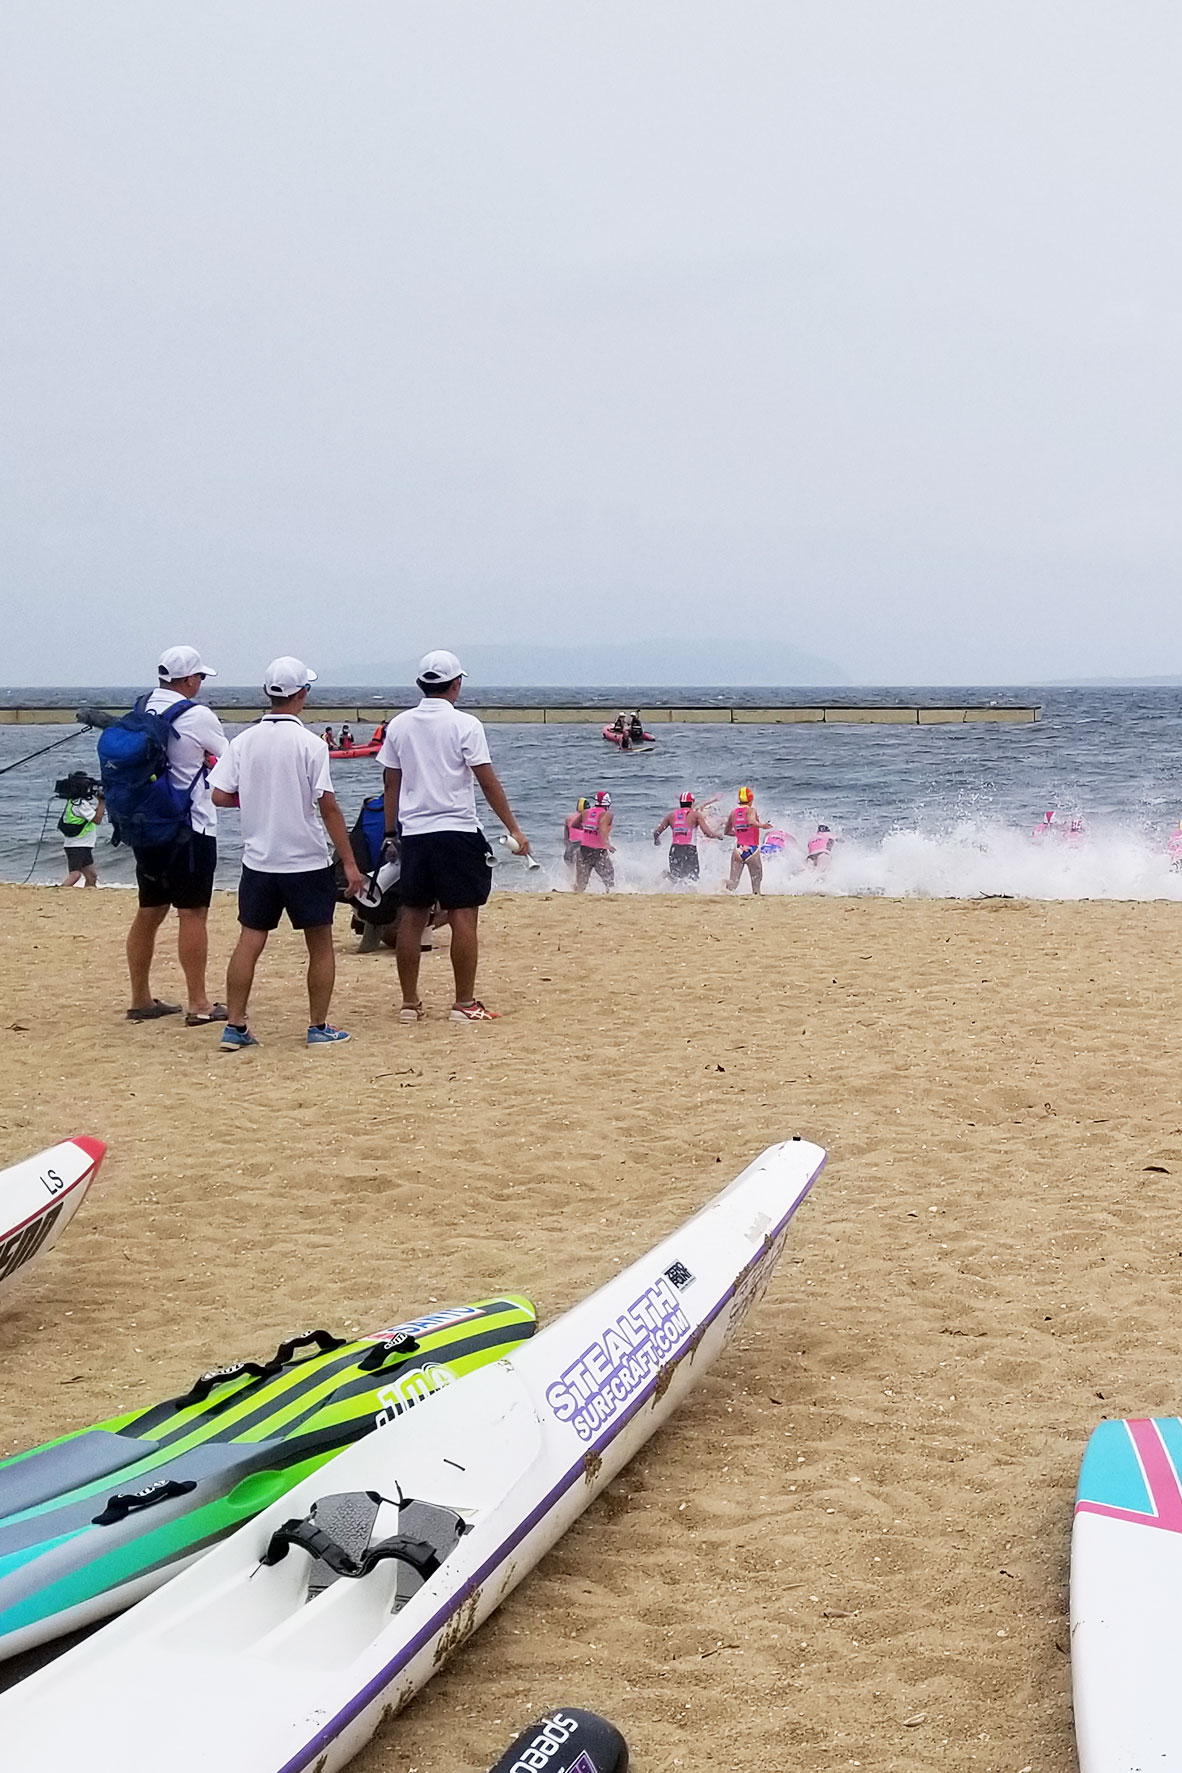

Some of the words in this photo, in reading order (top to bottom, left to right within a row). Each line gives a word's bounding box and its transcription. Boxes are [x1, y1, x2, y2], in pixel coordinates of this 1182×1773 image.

[39, 1169, 64, 1195] LS
[546, 1277, 680, 1422] STEALTH
[572, 1307, 691, 1441] SURFCRAFT.COM
